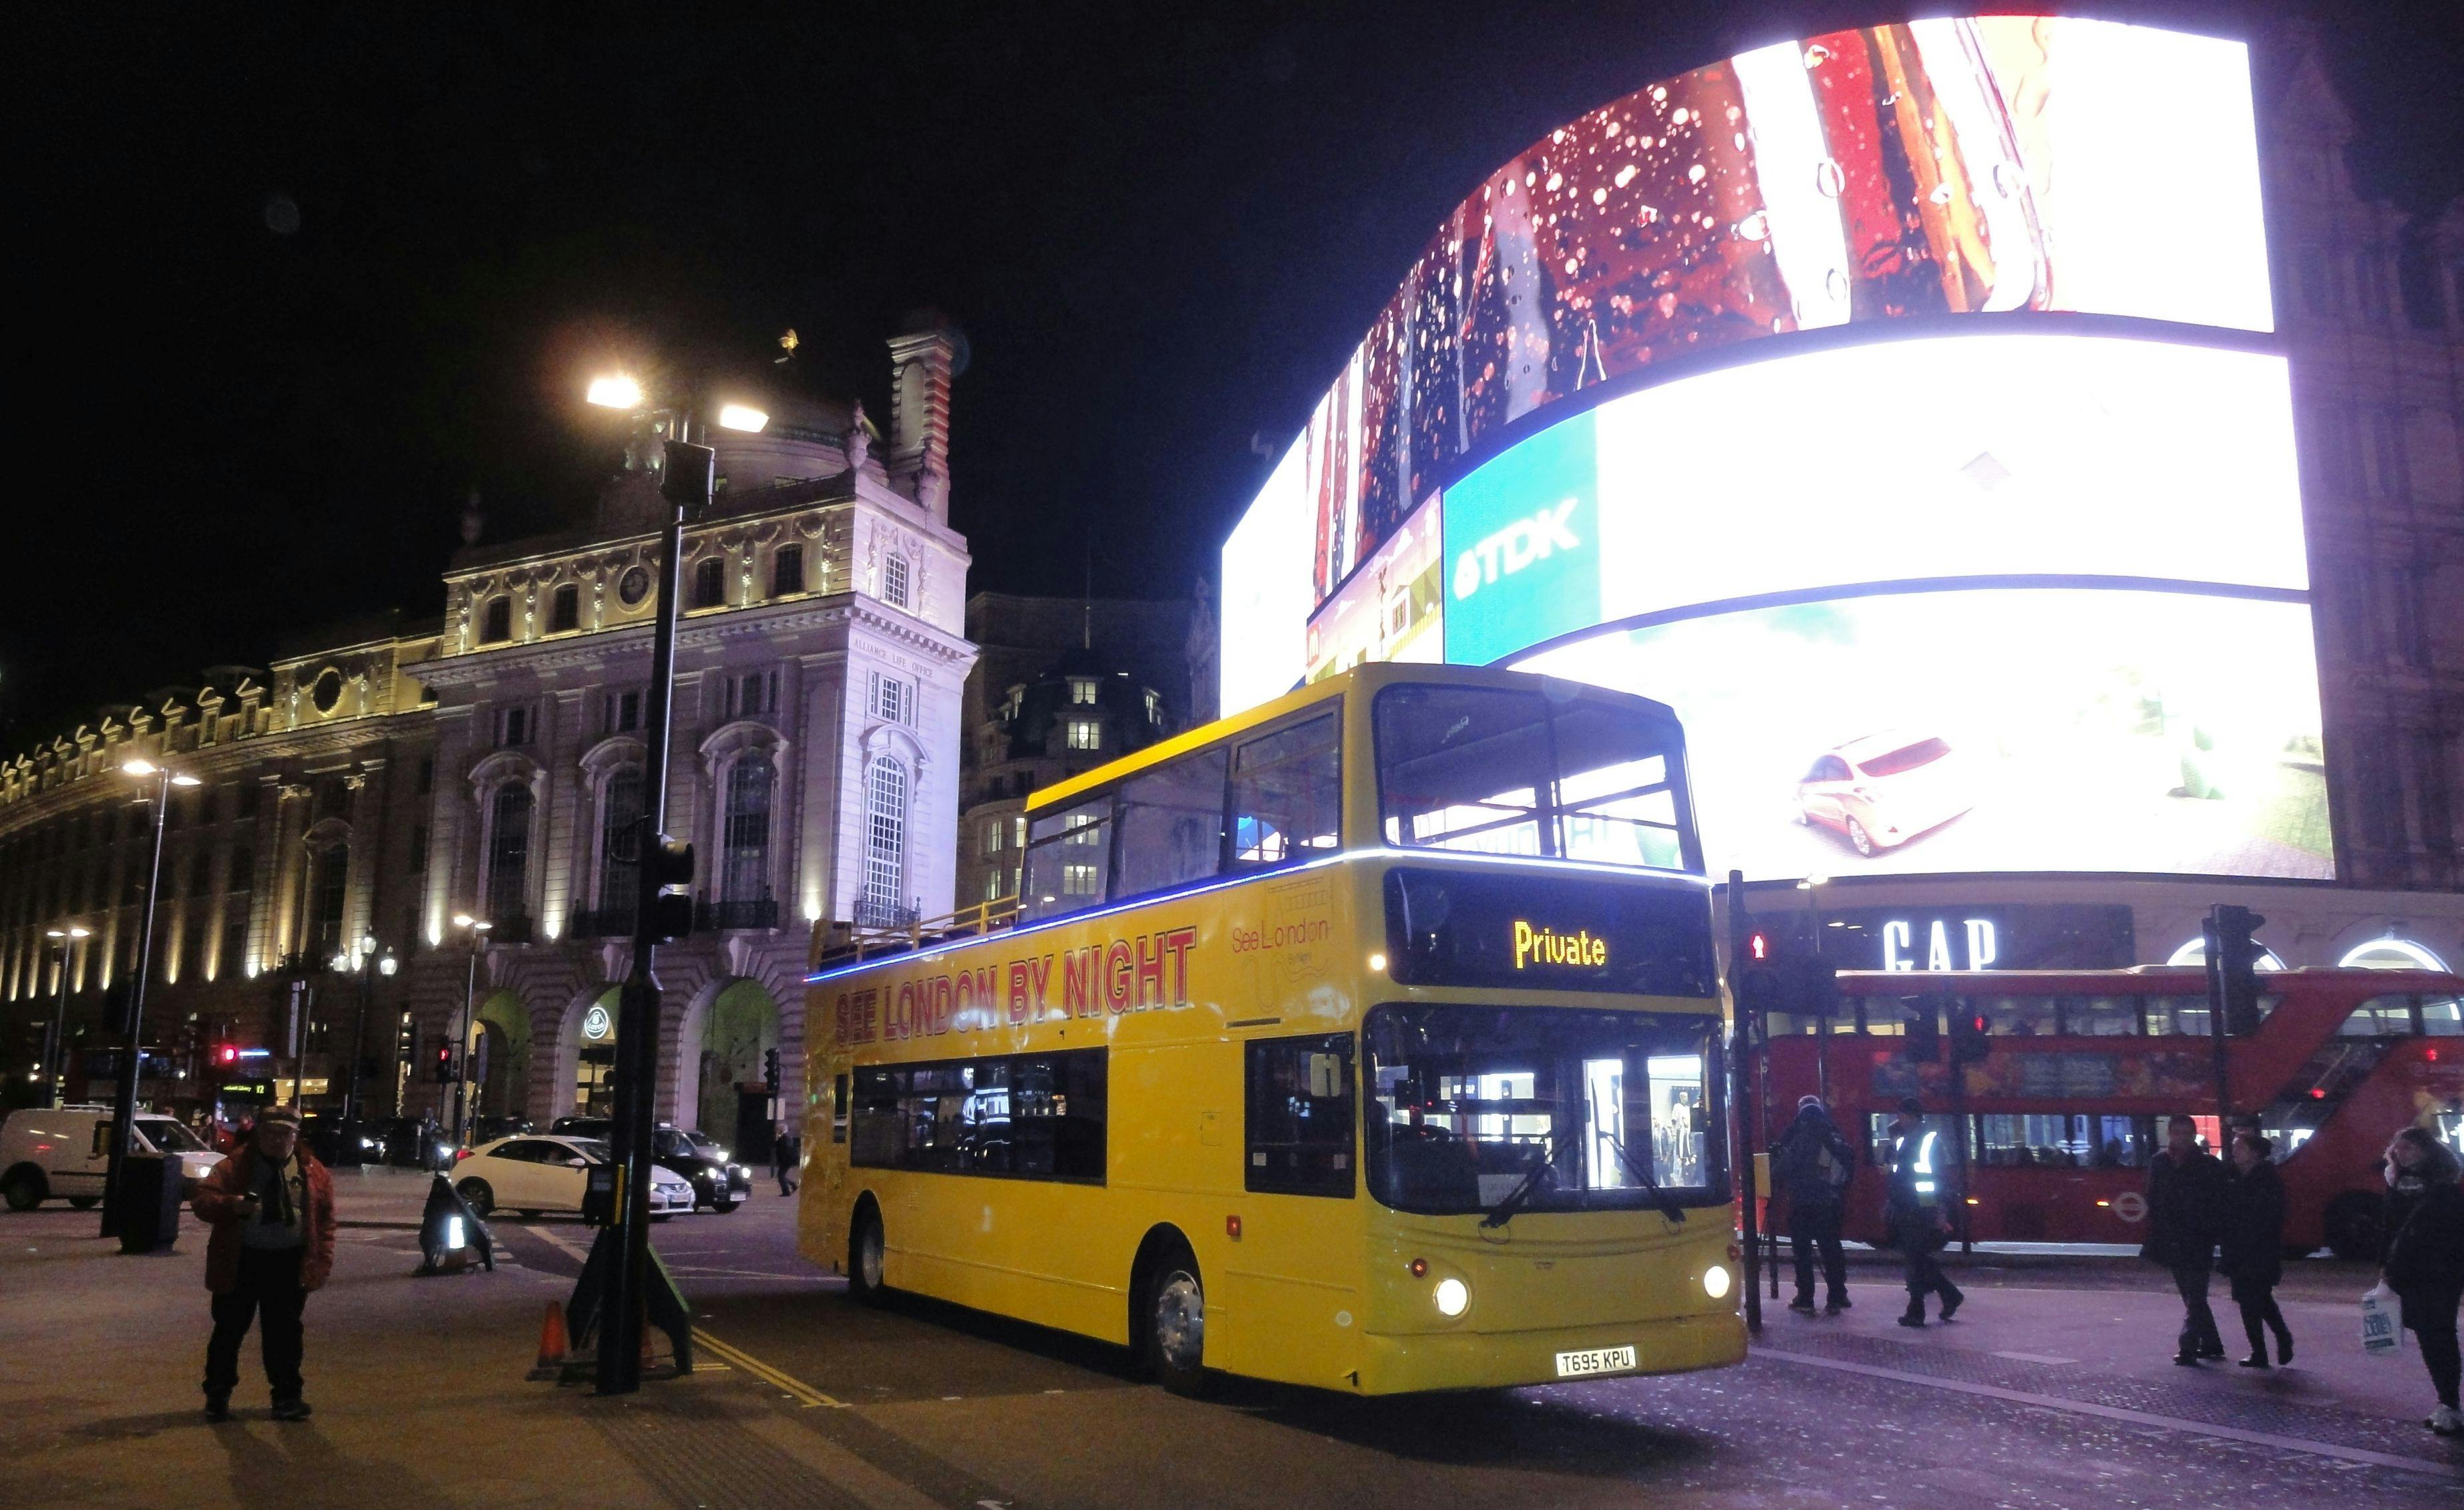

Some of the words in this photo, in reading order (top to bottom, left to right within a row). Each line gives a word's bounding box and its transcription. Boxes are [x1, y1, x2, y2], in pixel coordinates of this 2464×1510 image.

[1474, 498, 1580, 584] TDK
[854, 639, 887, 658] ALLIANCE
[892, 654, 907, 668] LIFE
[912, 662, 932, 678] OFFICE
[1514, 921, 1605, 968] Private
[1883, 919, 1996, 972] GAP
[836, 988, 877, 1047] SEE
[884, 966, 998, 1041] LONDON
[1008, 954, 1054, 1026] BY
[1063, 926, 1197, 1020] NIGHT
[1563, 1353, 1599, 1372] T695
[1604, 1350, 1630, 1368] KPU
